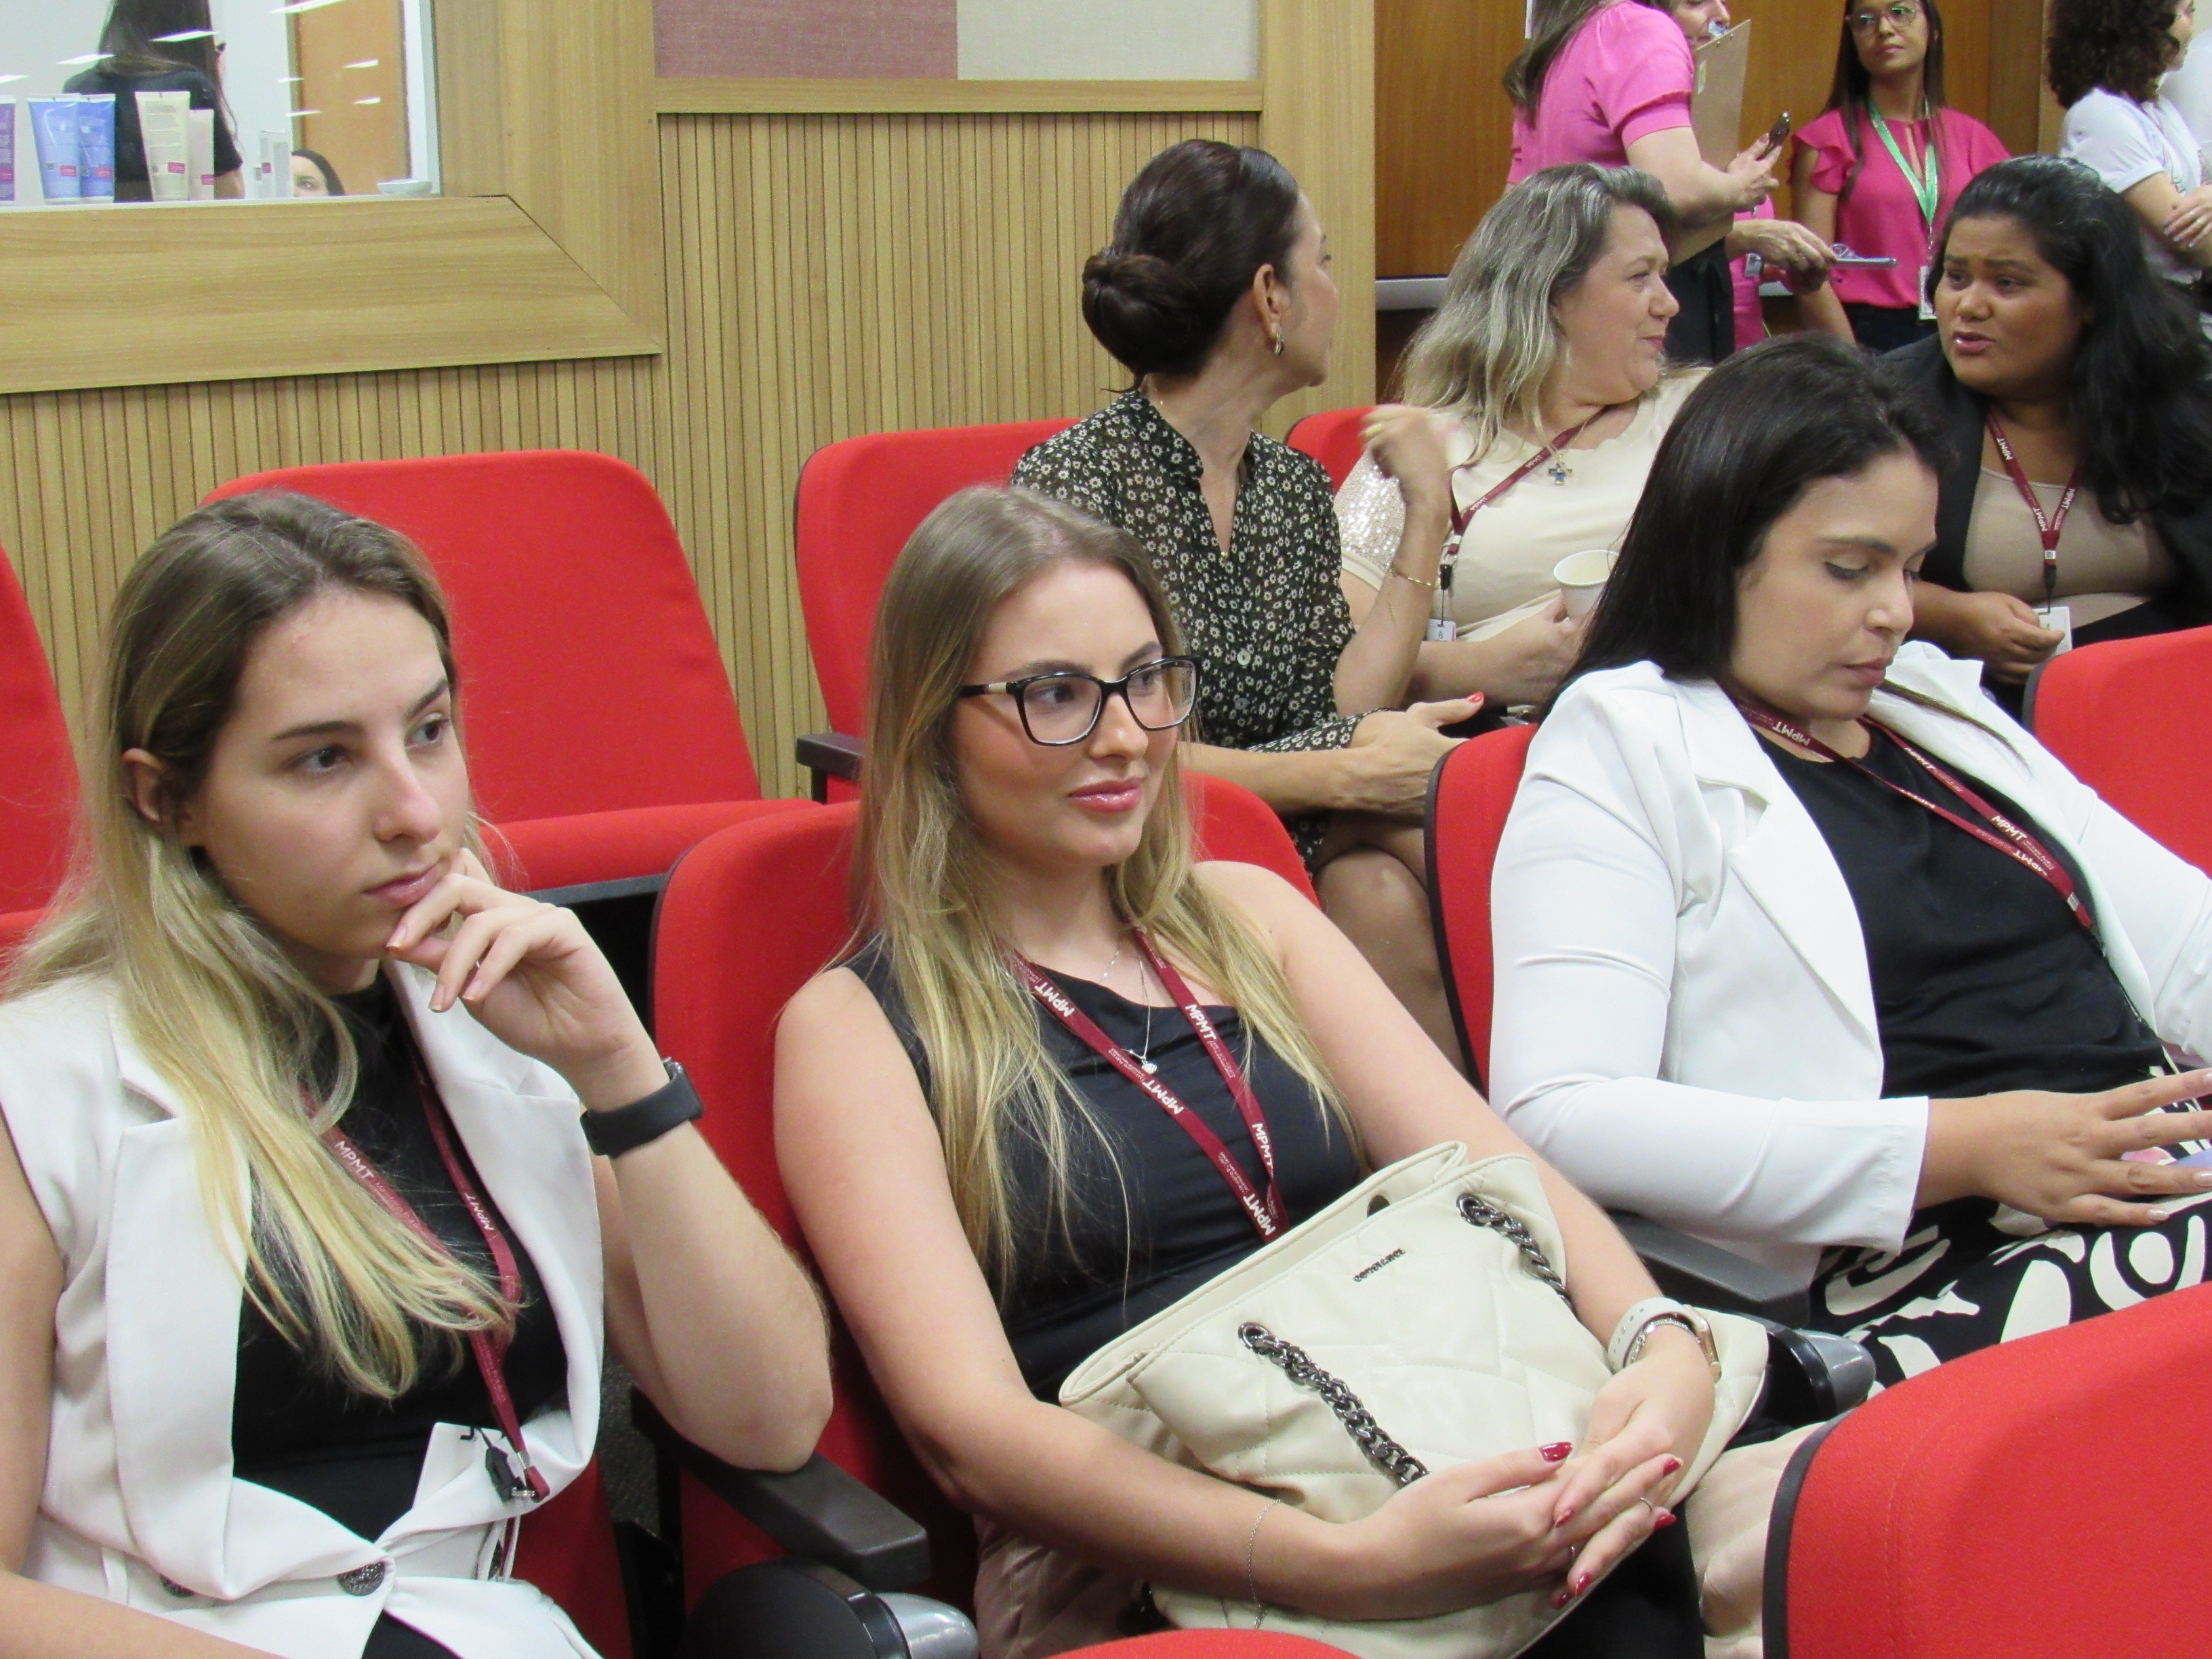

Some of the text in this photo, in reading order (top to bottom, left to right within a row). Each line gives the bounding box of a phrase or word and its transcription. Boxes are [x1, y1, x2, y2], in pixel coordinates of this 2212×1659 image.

[1996, 437, 2013, 460] MPMT
[2062, 488, 2076, 510] MPMT
[2033, 508, 2048, 531] MPMT
[1772, 721, 1810, 746] MPMT
[1991, 815, 2027, 840] MPMT
[1034, 982, 1075, 1017] MPMT
[1185, 1004, 1216, 1040] MPMT
[1142, 1080, 1184, 1115] MPMT
[333, 1140, 375, 1179] MPMT
[1252, 1123, 1273, 1170] MPMT
[464, 1192, 494, 1231] MPMT
[1243, 1193, 1276, 1235] MPMT
